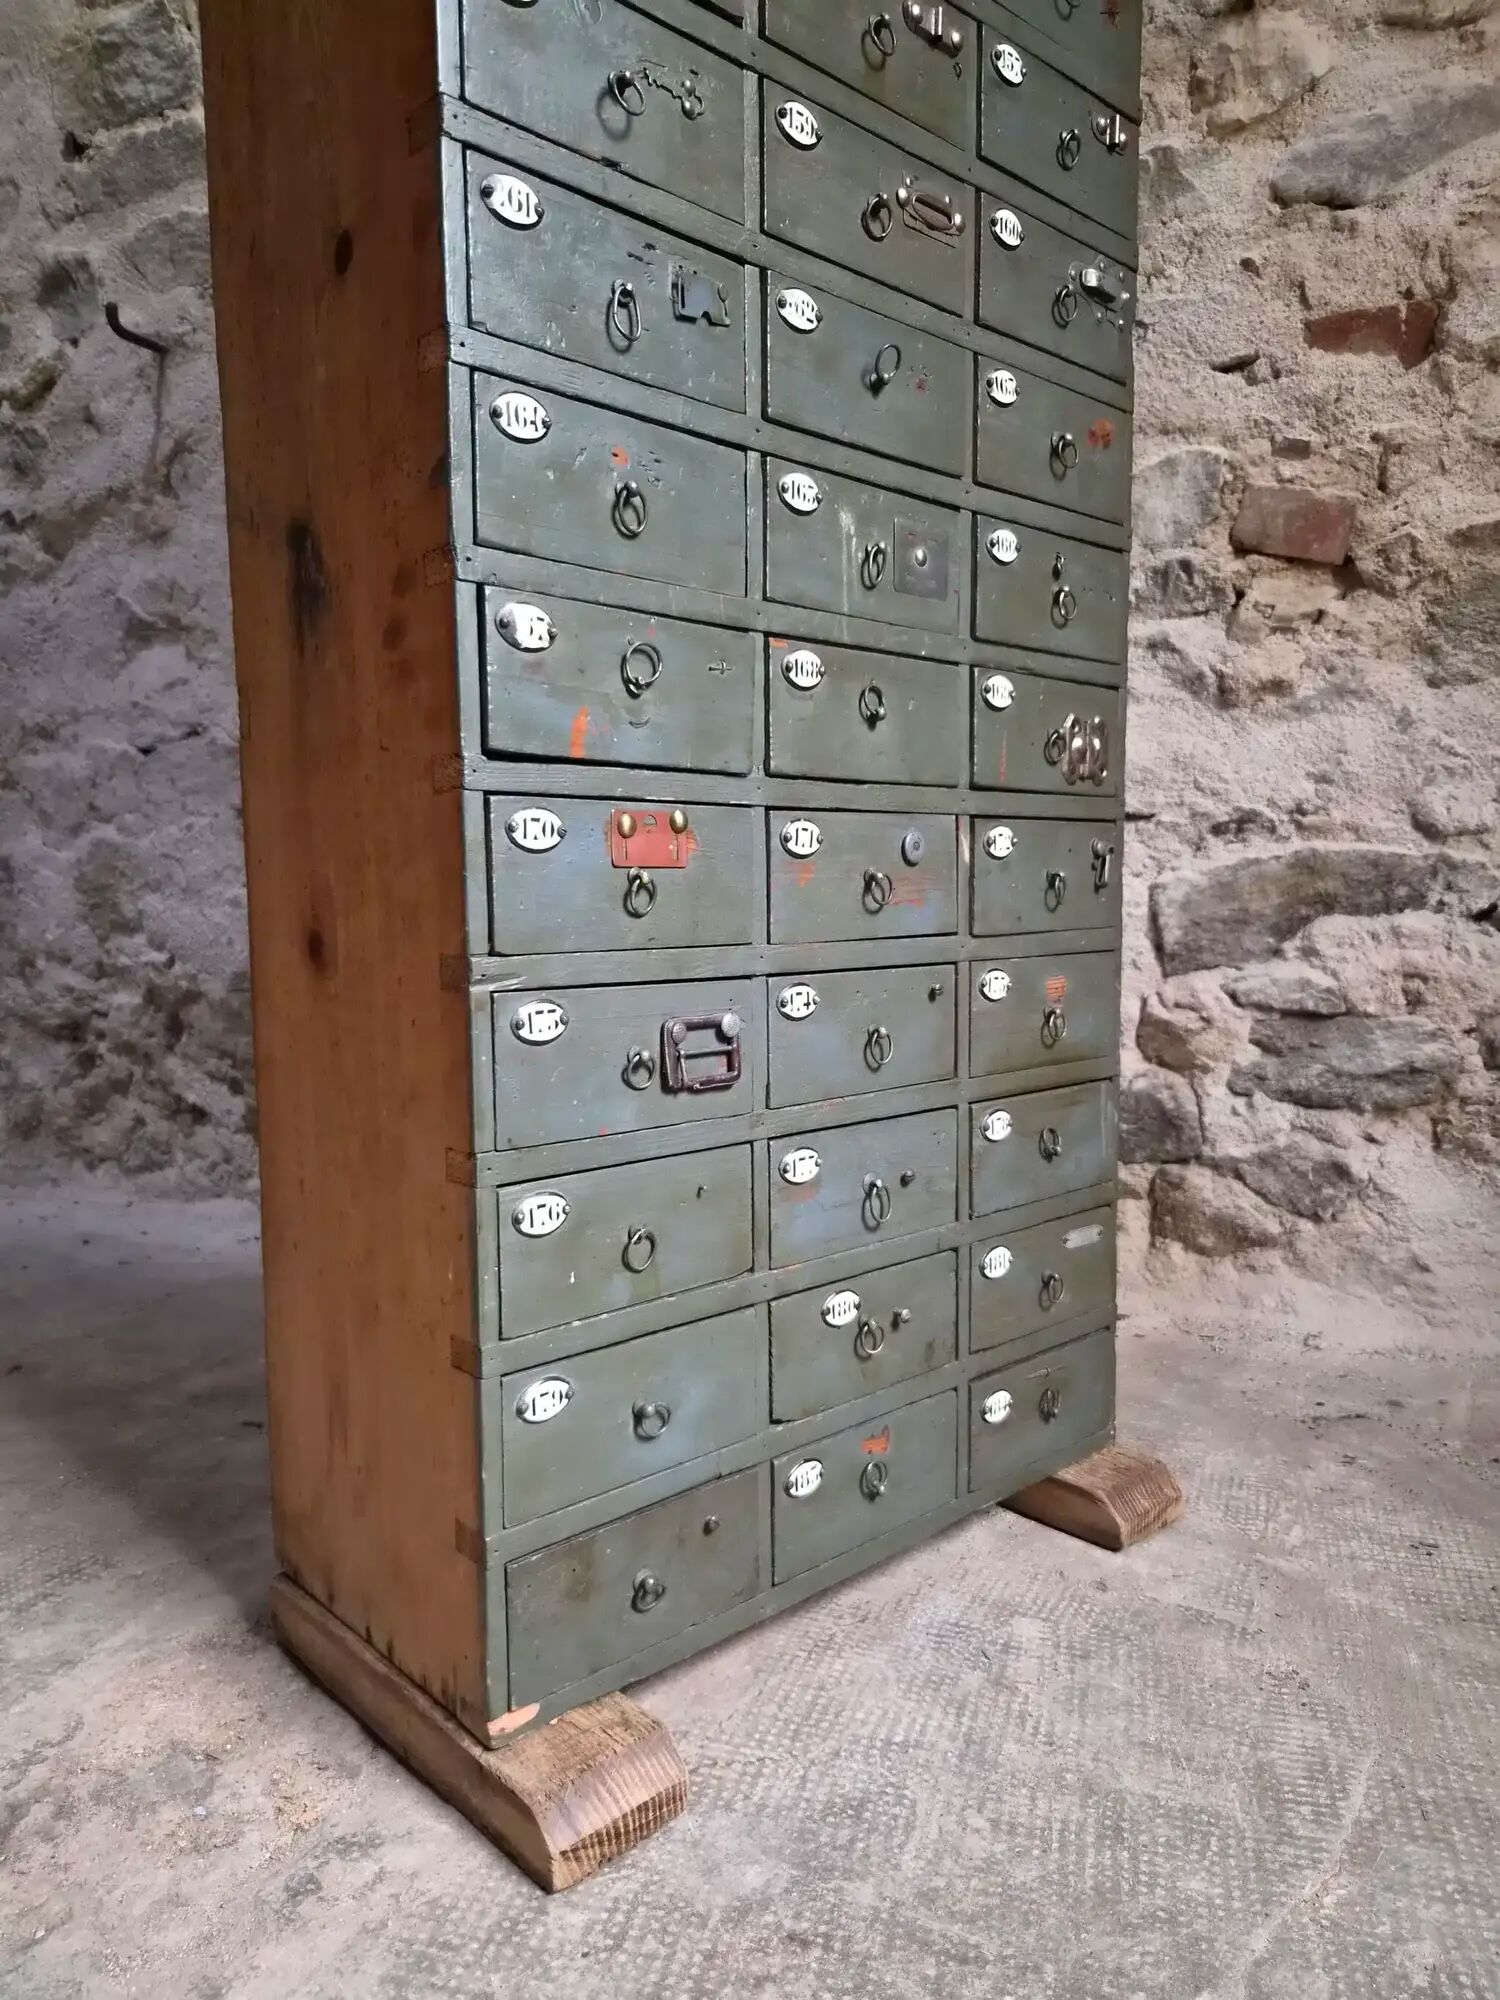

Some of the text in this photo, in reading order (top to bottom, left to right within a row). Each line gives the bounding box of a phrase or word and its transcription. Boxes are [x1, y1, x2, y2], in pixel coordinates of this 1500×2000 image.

[1002, 49, 1020, 77] 157
[789, 107, 814, 139] 159
[1000, 217, 1018, 240] 160
[506, 400, 539, 432] 164
[795, 658, 819, 679] 168
[523, 817, 555, 840] 170
[794, 827, 814, 848] 171
[790, 991, 812, 1012] 174
[528, 1009, 559, 1034] 173
[792, 1155, 815, 1178] 177
[529, 1203, 560, 1228] 176
[989, 1253, 1007, 1273] 181
[532, 1389, 563, 1416] 179
